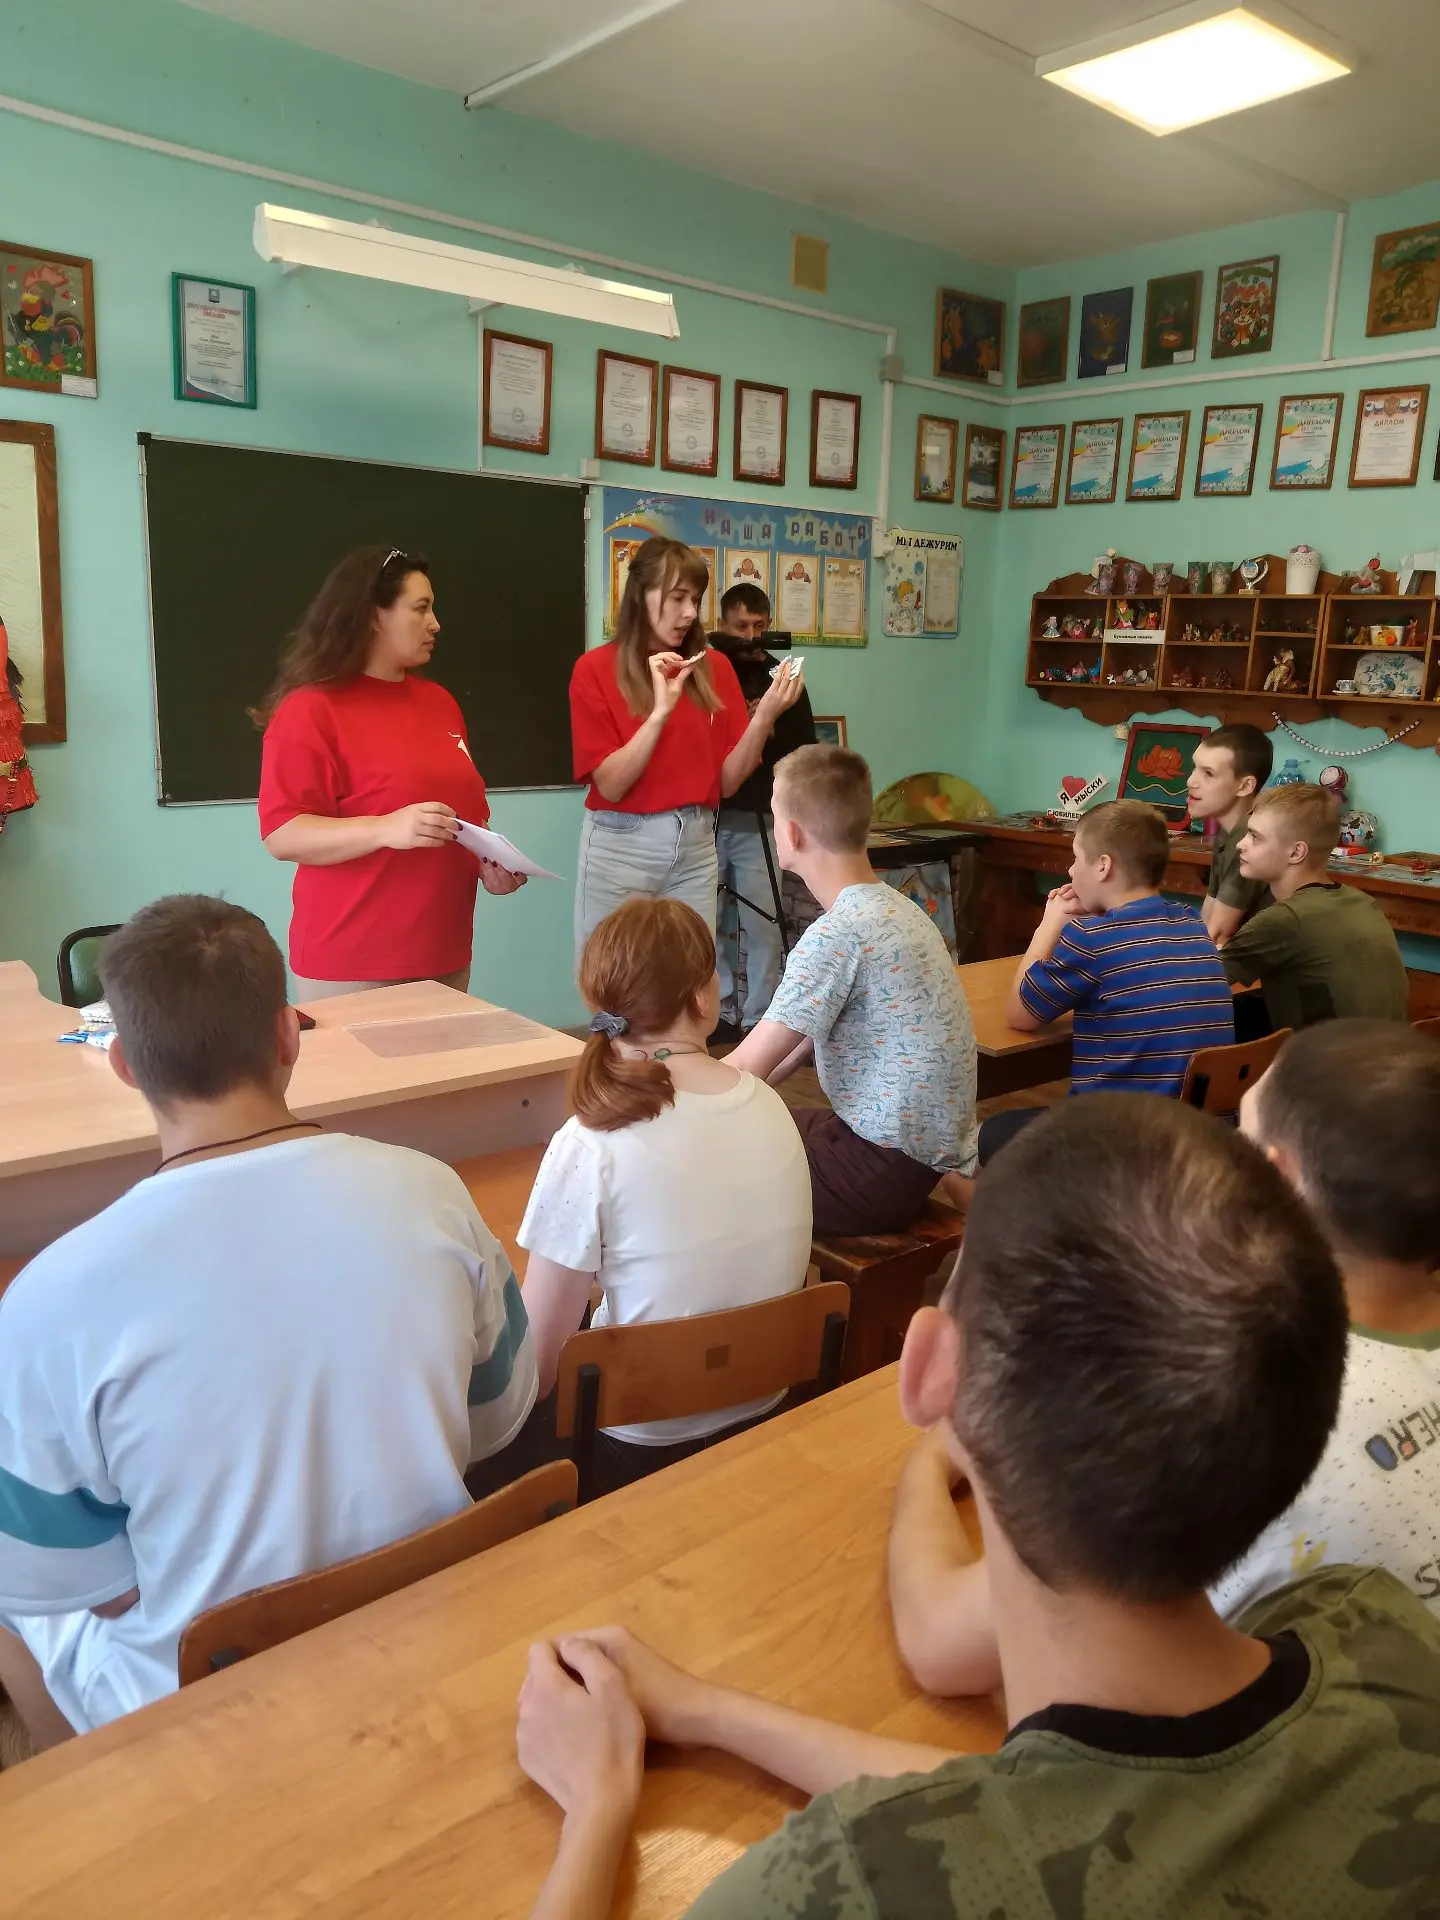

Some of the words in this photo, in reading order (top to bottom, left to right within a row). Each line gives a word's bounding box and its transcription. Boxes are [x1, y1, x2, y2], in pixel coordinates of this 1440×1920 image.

[1373, 418, 1405, 428] ДИПЛОМ
[703, 508, 772, 540] НАША
[790, 521, 867, 551] РАБОТА
[895, 536, 912, 547] МЫ
[914, 538, 958, 551] ДЕЖУРИМ
[1059, 792, 1070, 805] Я
[1074, 777, 1103, 805] МЫСКИ
[1053, 811, 1082, 819] ЮБИЛЕЕ
